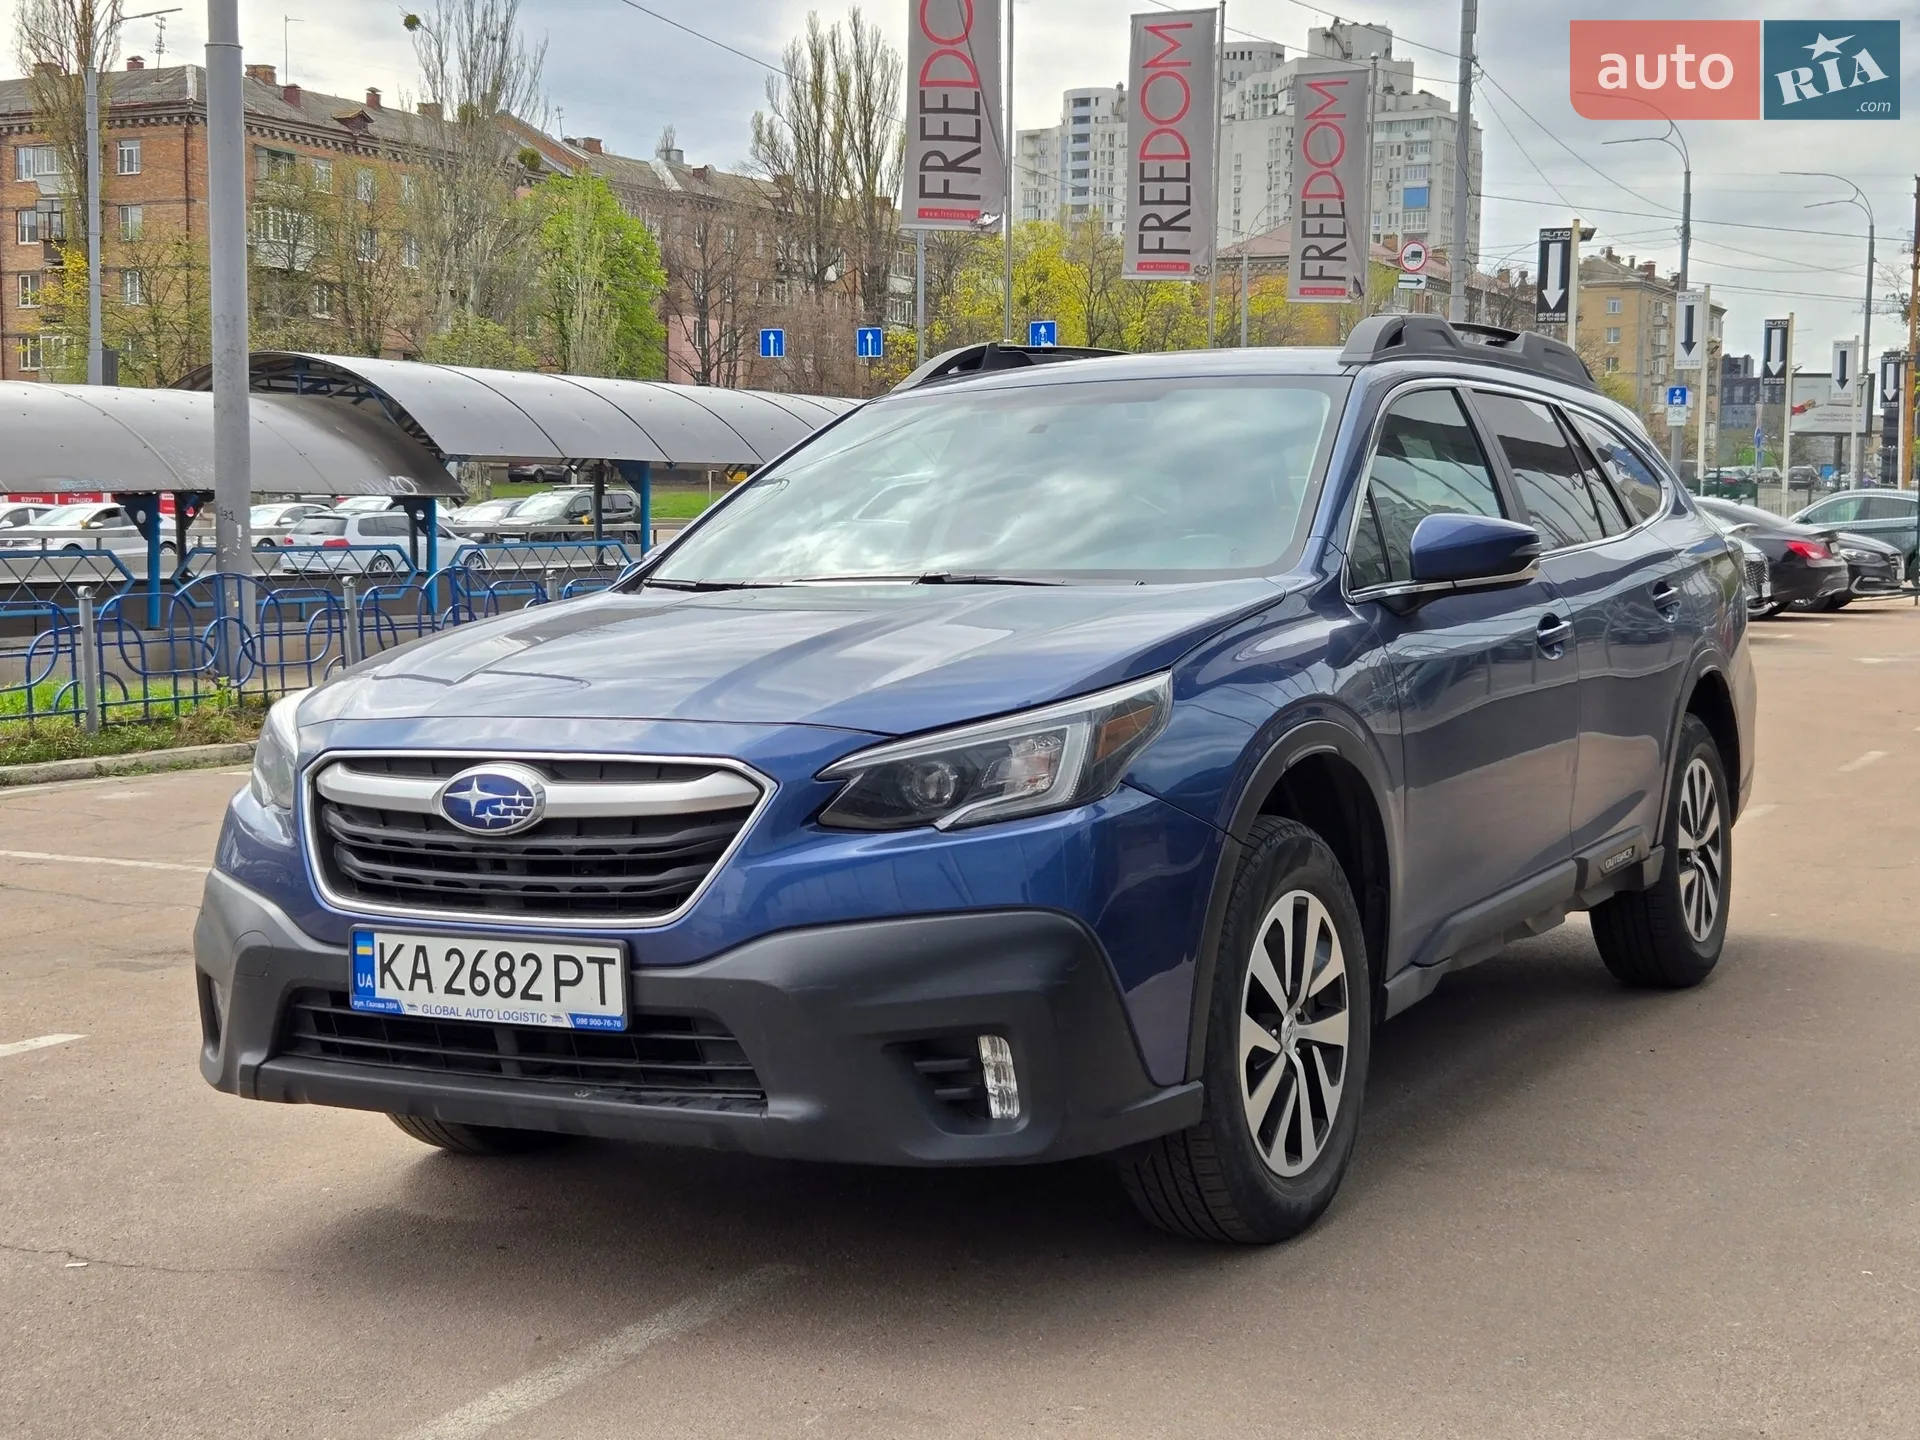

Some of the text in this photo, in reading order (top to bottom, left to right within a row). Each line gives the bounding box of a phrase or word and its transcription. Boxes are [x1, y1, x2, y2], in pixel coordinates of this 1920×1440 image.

[1138, 22, 1193, 256] FREEDOM
[1300, 80, 1349, 282] FREEDOM
[1605, 847, 1633, 869] OUTBACK
[357, 972, 374, 989] UA
[378, 941, 616, 1006] KA 2682 PT
[421, 1003, 547, 1023] GLOBAL AUTO LOGISTIC
